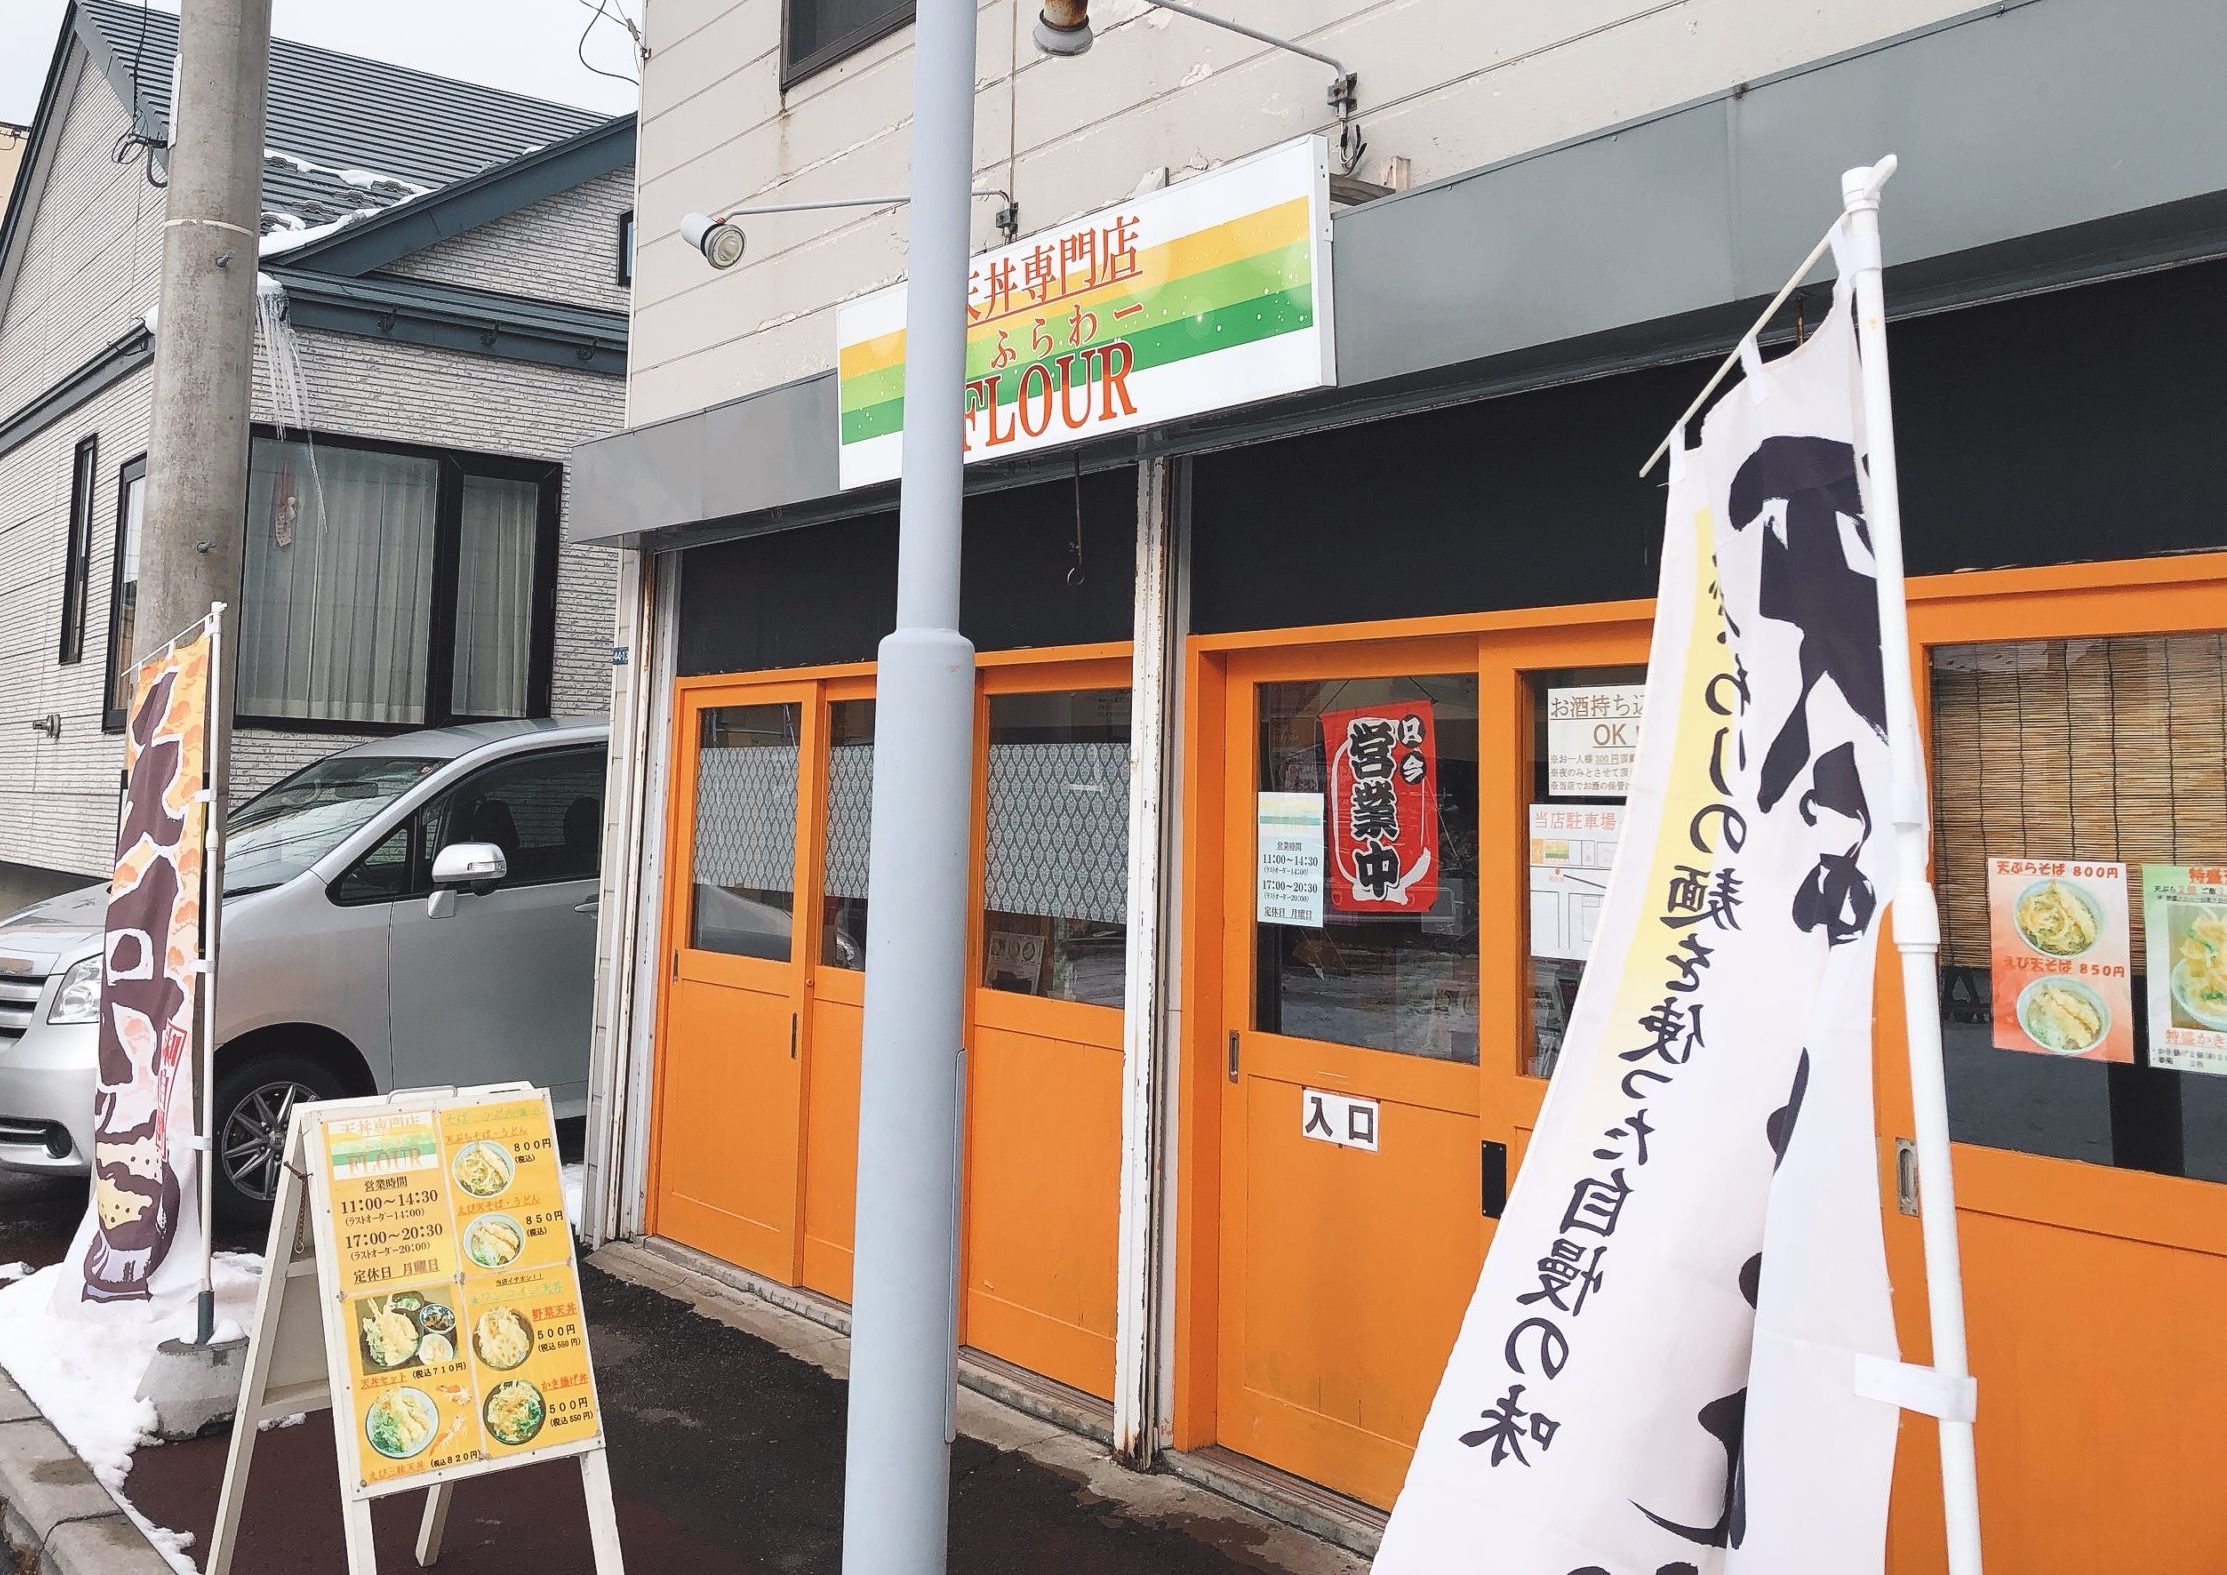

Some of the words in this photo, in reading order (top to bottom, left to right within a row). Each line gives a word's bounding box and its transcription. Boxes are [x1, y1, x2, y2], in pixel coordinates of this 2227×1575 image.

[991, 303, 1144, 368] ふらわー
[963, 340, 1138, 453] FLOUR
[1402, 716, 1424, 784] 只今
[1349, 719, 1400, 899] 営業中
[1535, 811, 1617, 831] 当店駐車場
[1997, 860, 2066, 876] 天ぷらそば
[2072, 865, 2119, 879] 800円
[2003, 956, 2072, 974] えび天そば
[2079, 964, 2125, 978] 850円
[1305, 1096, 1374, 1144] 入口
[513, 1138, 552, 1152] 800円
[364, 1176, 408, 1193] 営業時間
[525, 1210, 564, 1225] 850円
[353, 1265, 392, 1284] 定休日
[402, 1258, 440, 1277] 月曜日
[537, 1324, 576, 1340] 500円
[549, 1397, 589, 1414] 500円
